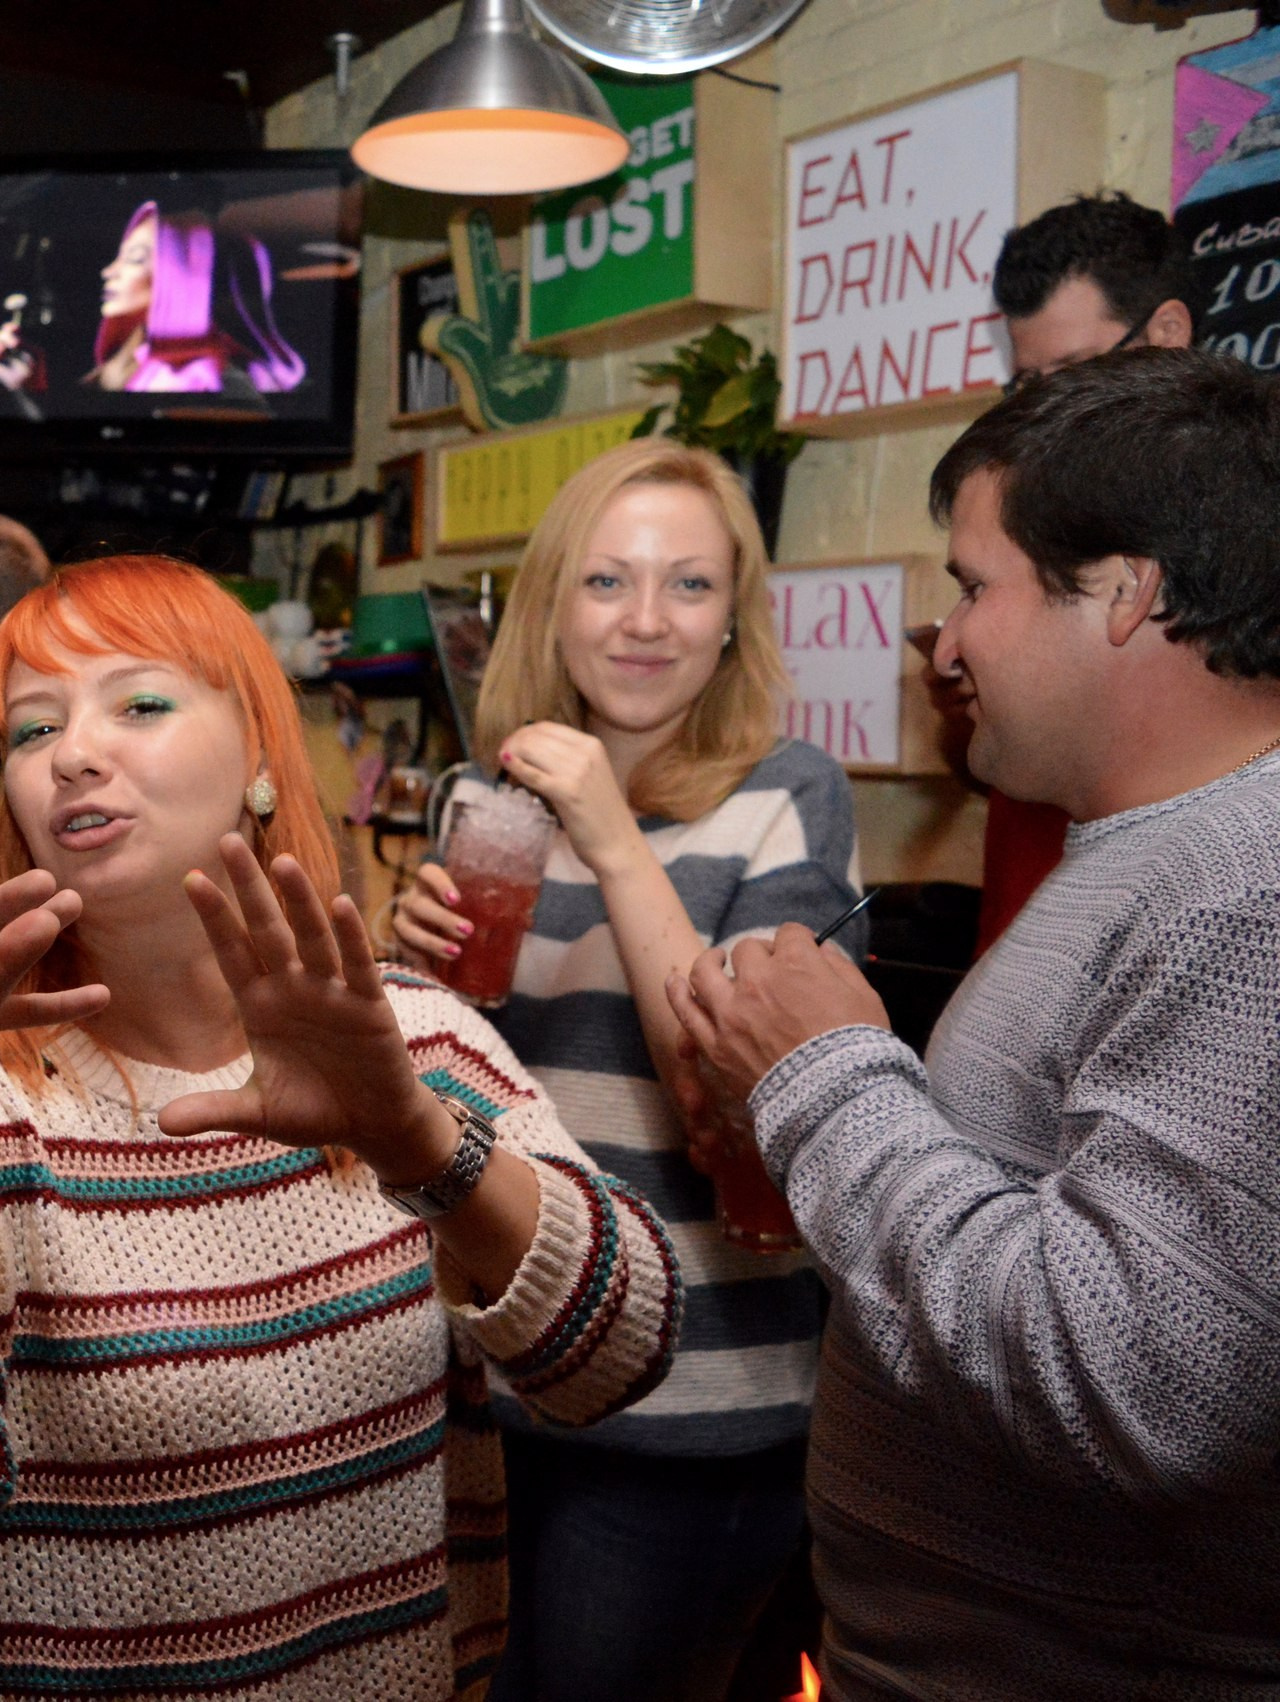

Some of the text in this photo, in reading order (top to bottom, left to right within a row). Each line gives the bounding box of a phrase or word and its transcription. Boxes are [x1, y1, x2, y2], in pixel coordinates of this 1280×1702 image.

[627, 106, 695, 167] GET
[796, 129, 916, 229] EAT,
[532, 160, 694, 284] LOST
[793, 208, 992, 325] DRINK,
[792, 311, 1006, 421] DANCE
